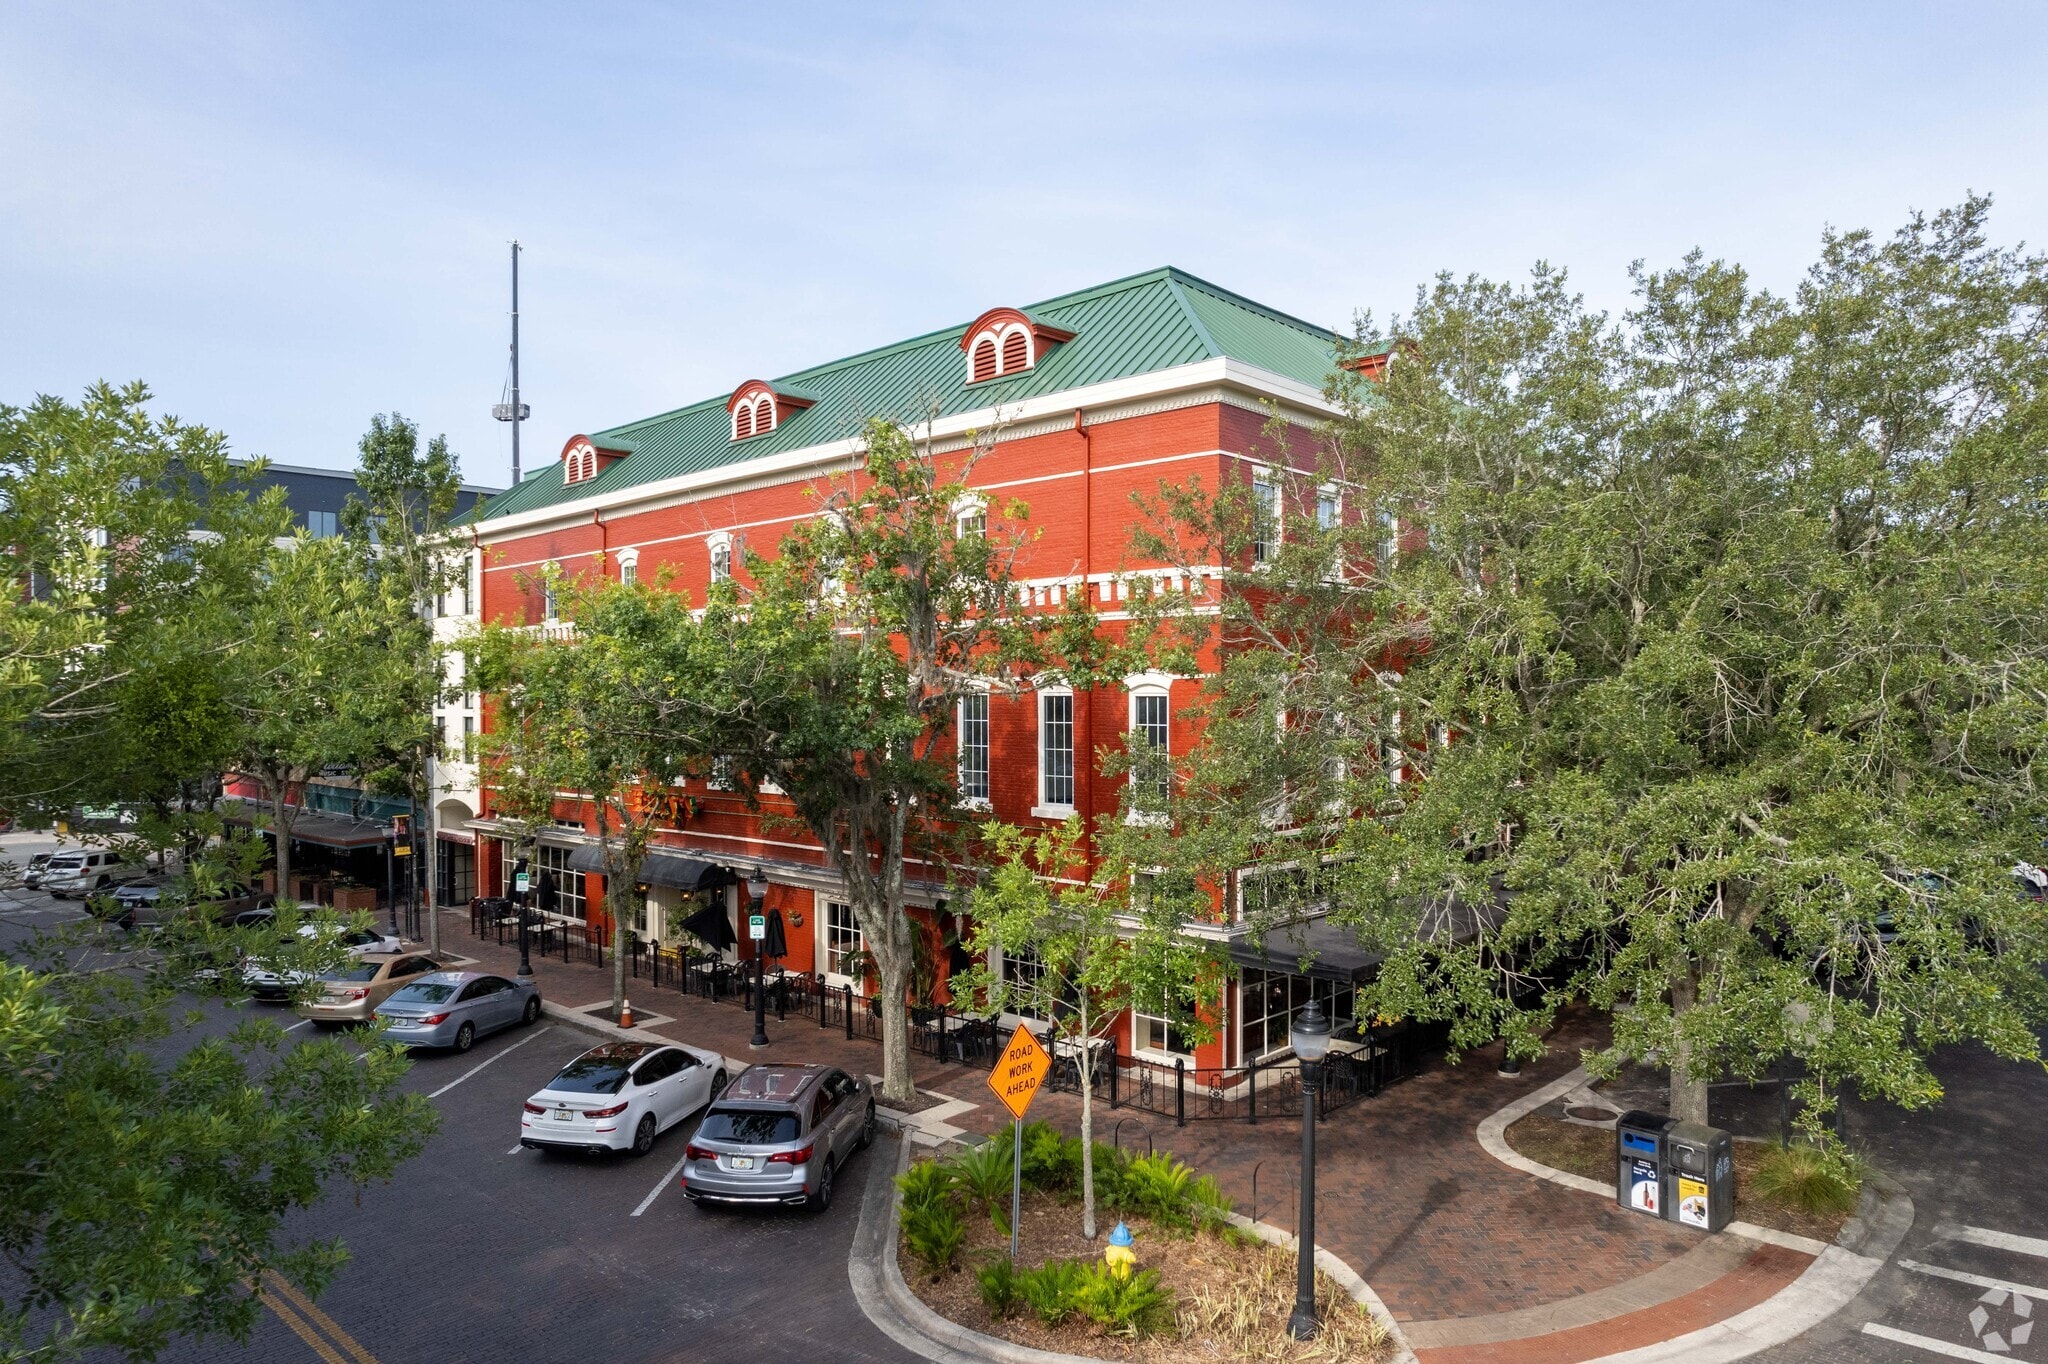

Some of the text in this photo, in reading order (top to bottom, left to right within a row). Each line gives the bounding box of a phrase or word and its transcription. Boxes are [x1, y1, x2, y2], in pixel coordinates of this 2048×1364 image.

[1009, 1044, 1033, 1062] ROAD
[1009, 1061, 1033, 1079] WORK
[1006, 1077, 1036, 1097] AHEAD
